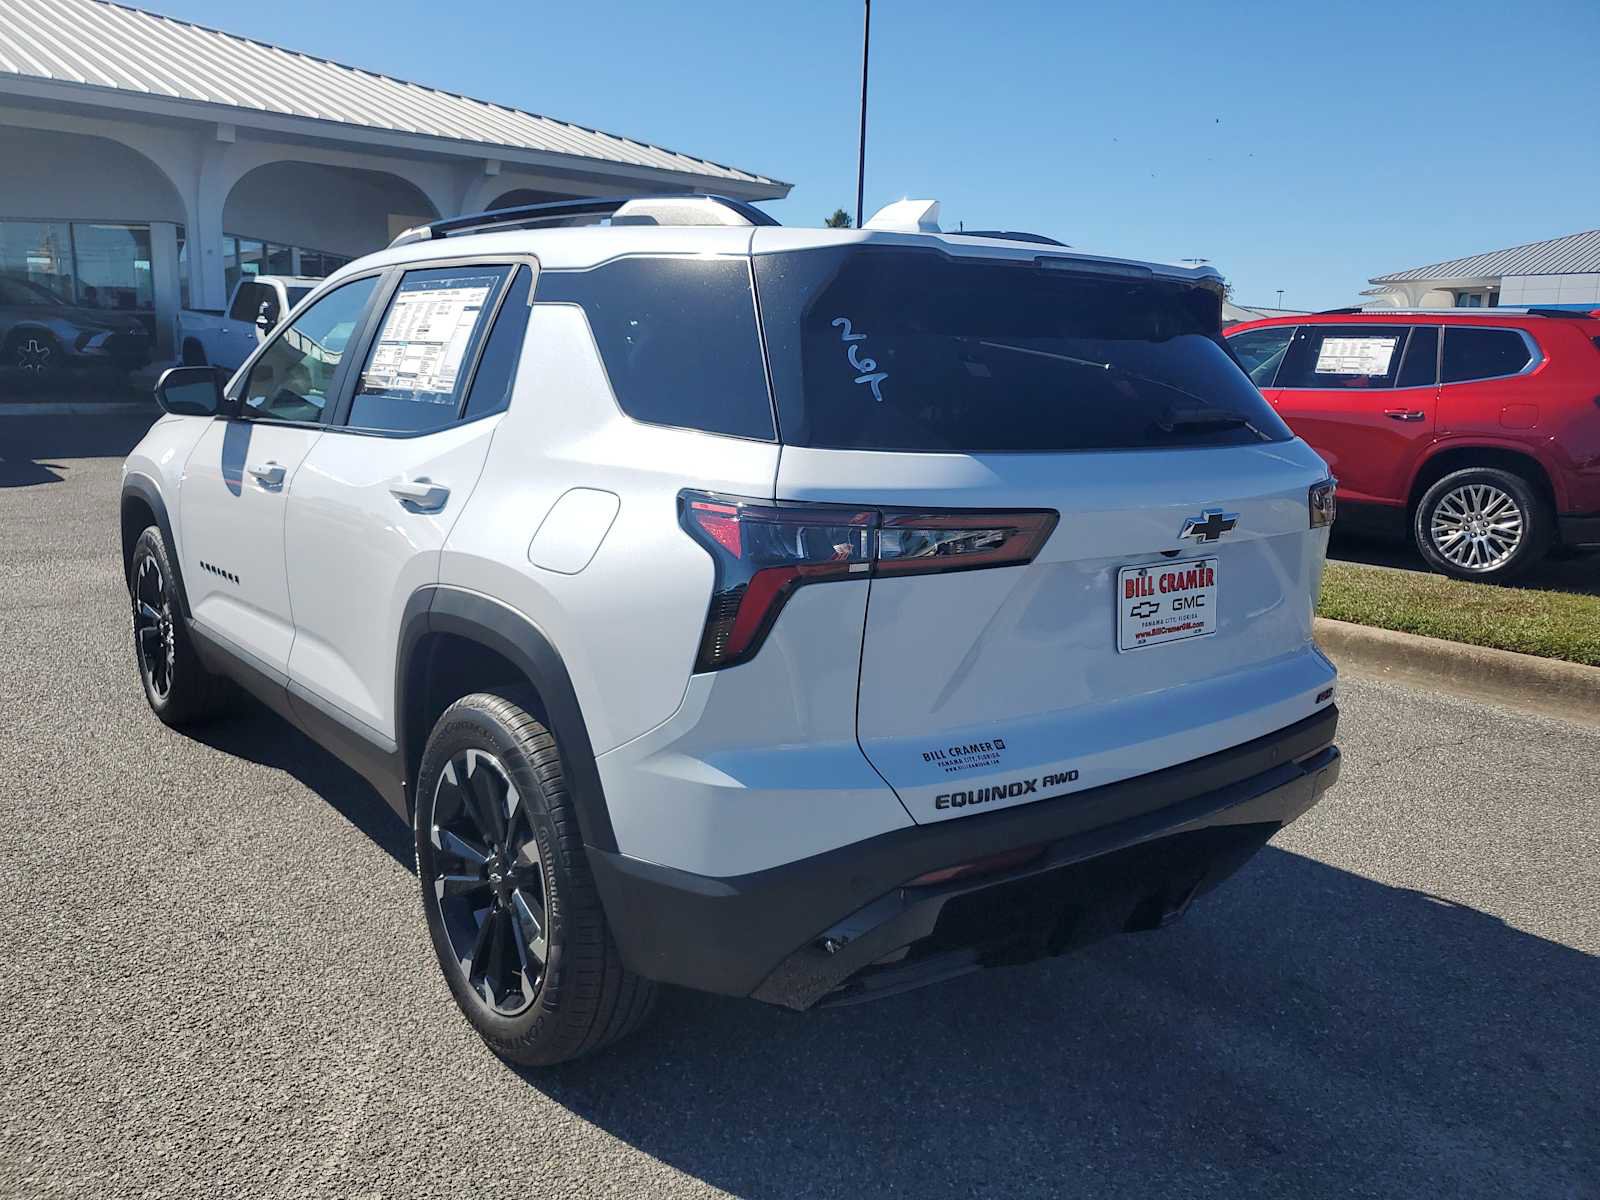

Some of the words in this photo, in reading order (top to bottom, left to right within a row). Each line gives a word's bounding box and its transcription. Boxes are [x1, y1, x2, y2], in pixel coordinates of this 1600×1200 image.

[1125, 575, 1154, 599] BILL
[1159, 567, 1214, 594] CRAMER
[1172, 595, 1205, 611] GMC
[922, 749, 947, 762] BILL
[949, 741, 993, 757] CRAMER
[935, 778, 1038, 810] EQUINOX
[1042, 769, 1079, 788] AWD
